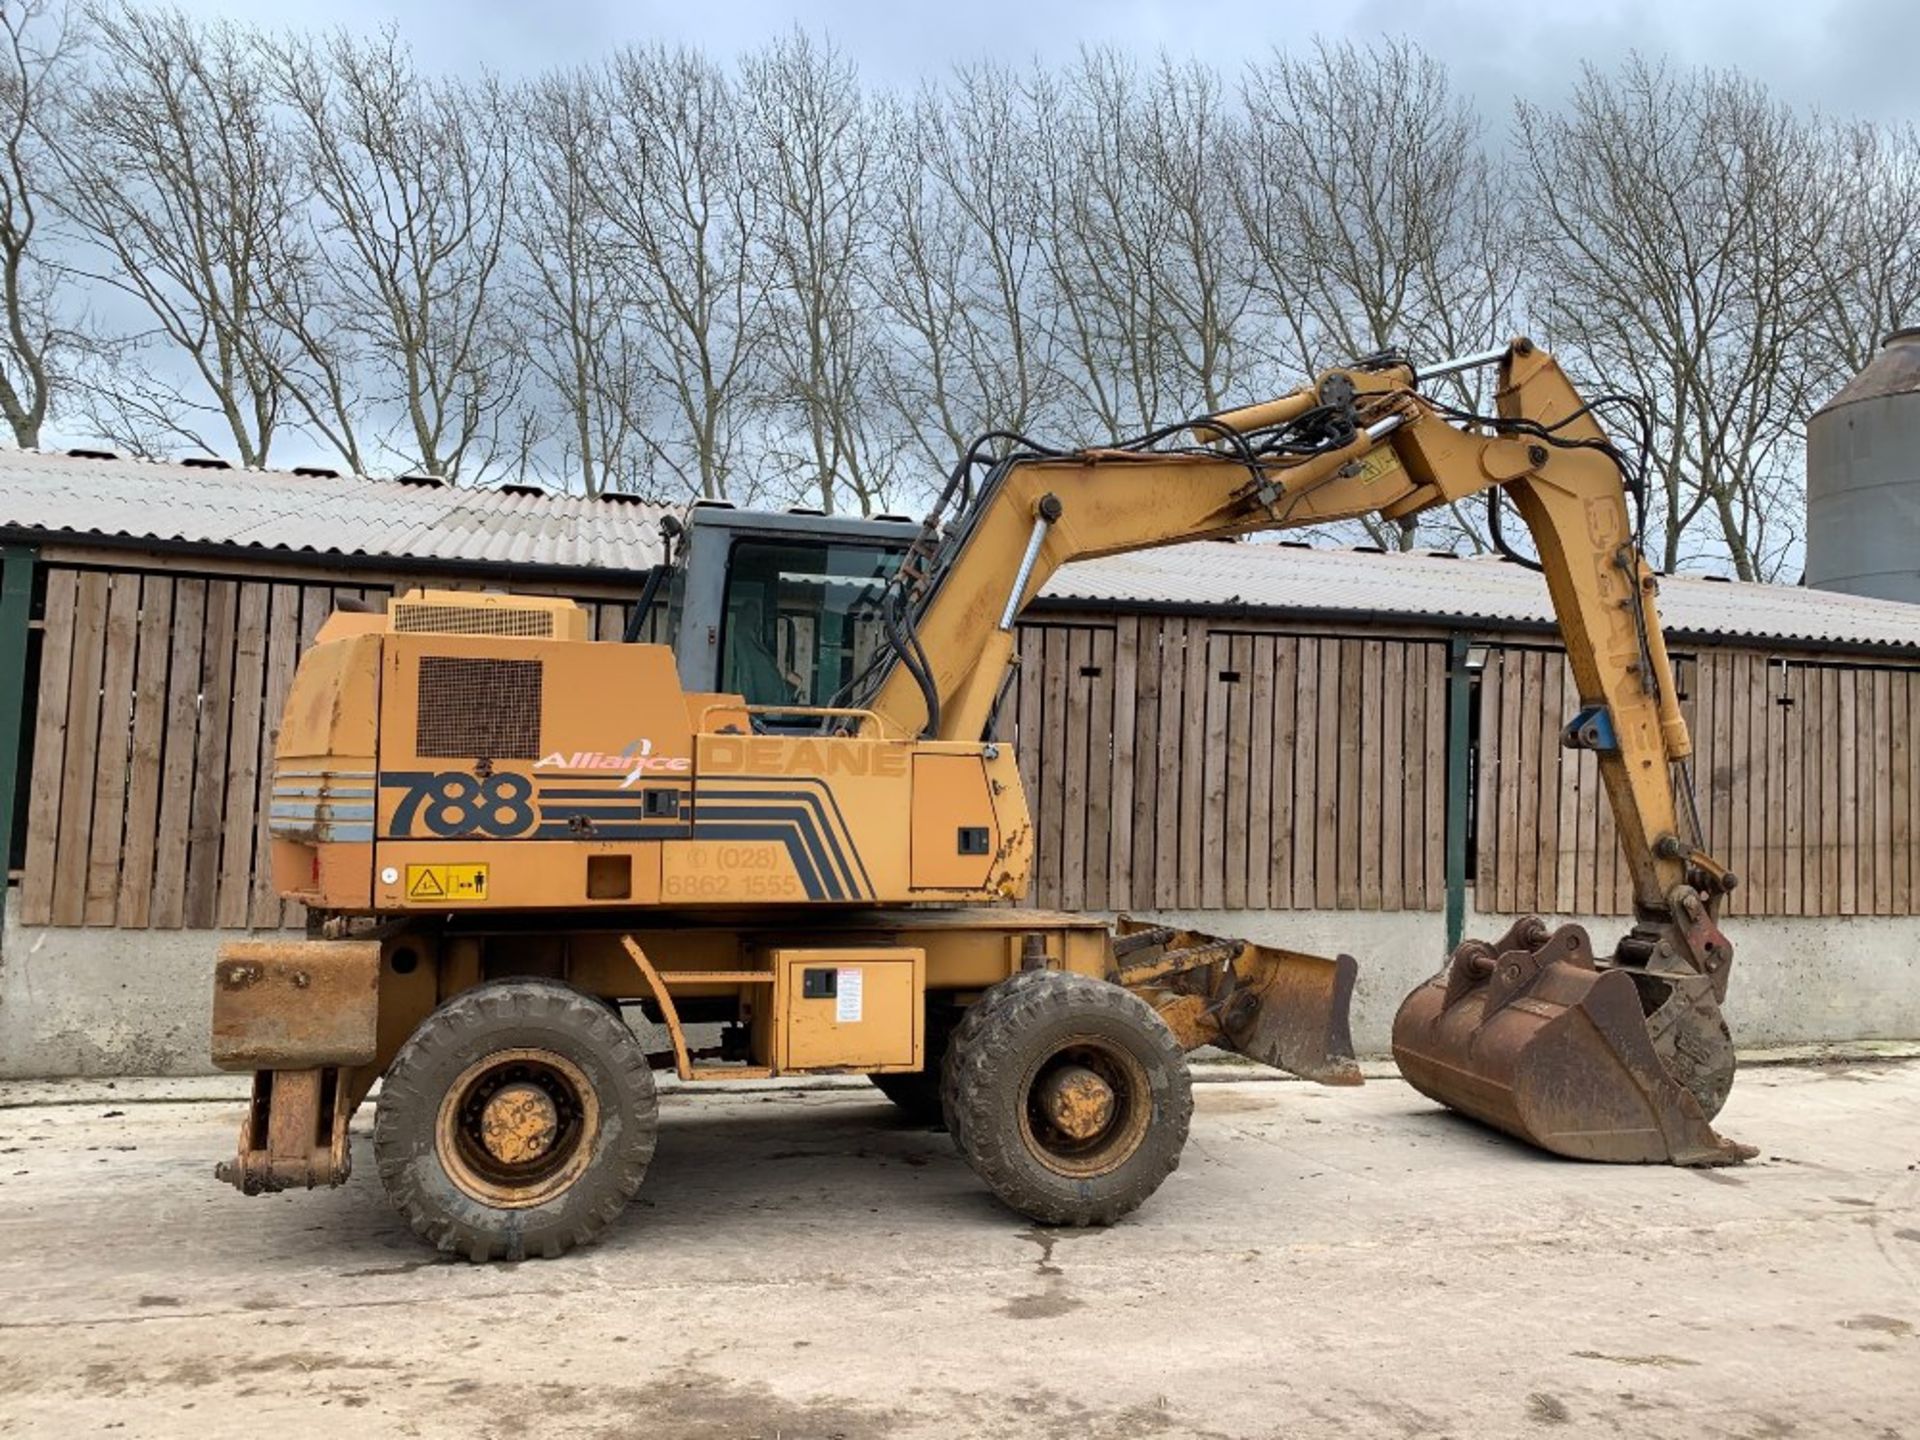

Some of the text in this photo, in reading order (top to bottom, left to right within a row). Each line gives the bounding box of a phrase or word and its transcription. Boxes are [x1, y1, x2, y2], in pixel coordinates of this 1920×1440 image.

[533, 751, 692, 771] Alliance
[700, 739, 906, 776] DEANE
[379, 772, 534, 836] 788
[716, 846, 777, 870] (028)
[665, 875, 796, 896] 6862 1555
